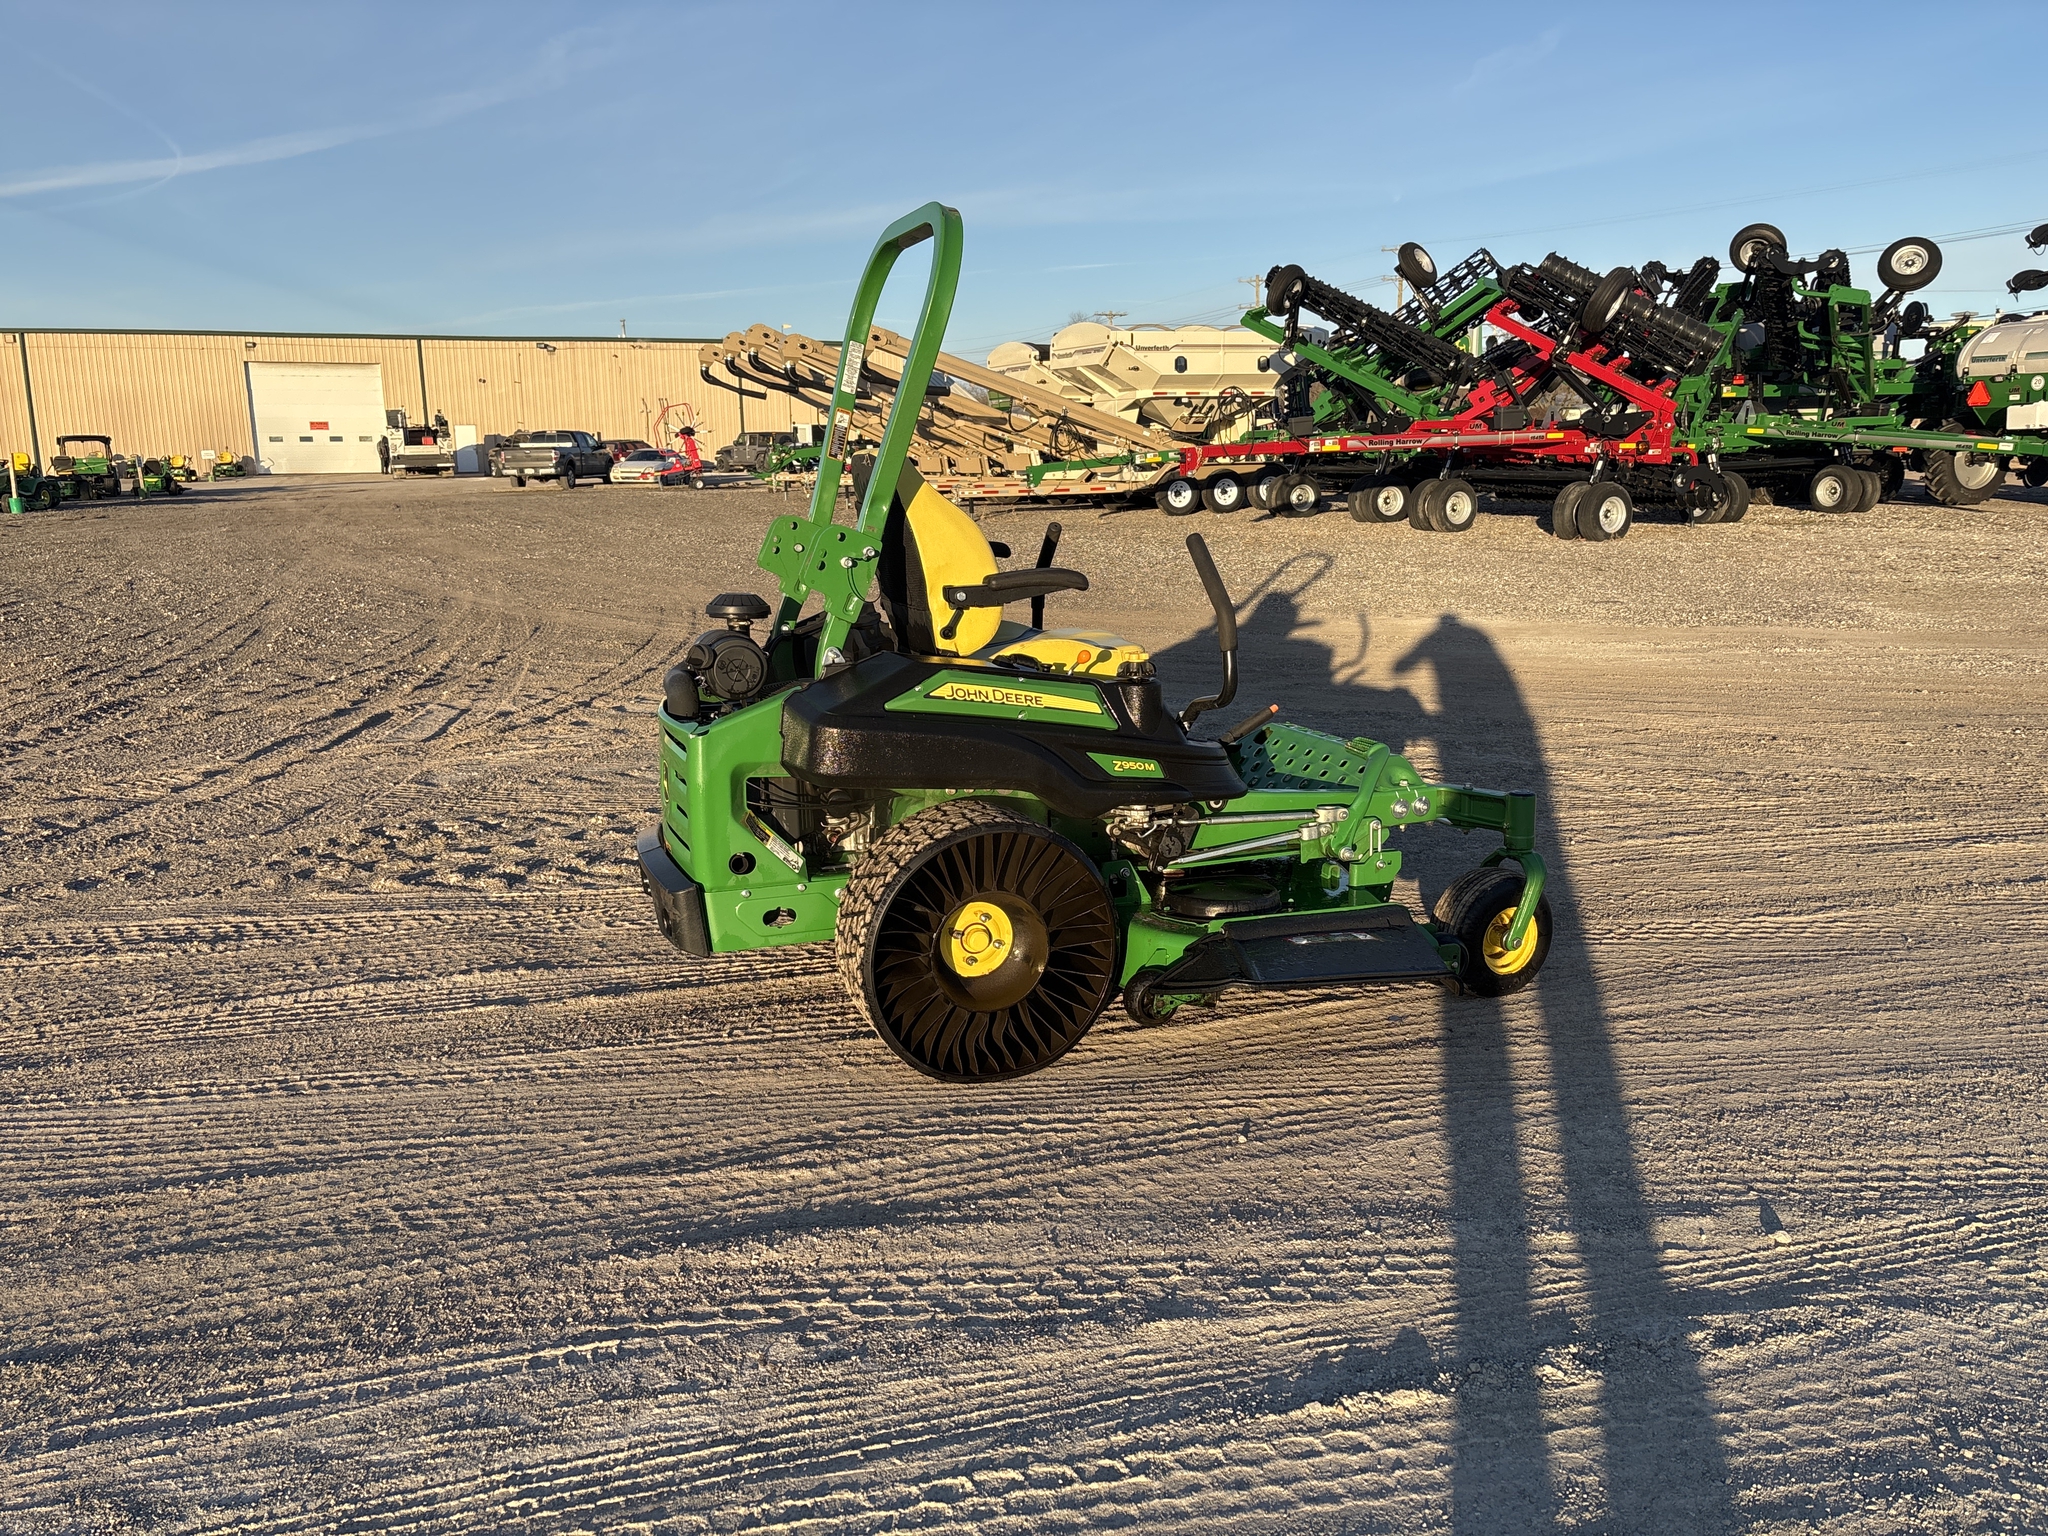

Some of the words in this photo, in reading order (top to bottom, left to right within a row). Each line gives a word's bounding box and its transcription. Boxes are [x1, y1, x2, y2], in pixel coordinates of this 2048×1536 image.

[1786, 429, 1810, 438] Rolling
[1811, 431, 1838, 439] Harrow
[1368, 439, 1393, 447] Rolling
[946, 685, 989, 701] JOHN
[992, 689, 1044, 706] DEERE
[1112, 760, 1155, 772] Z950M
